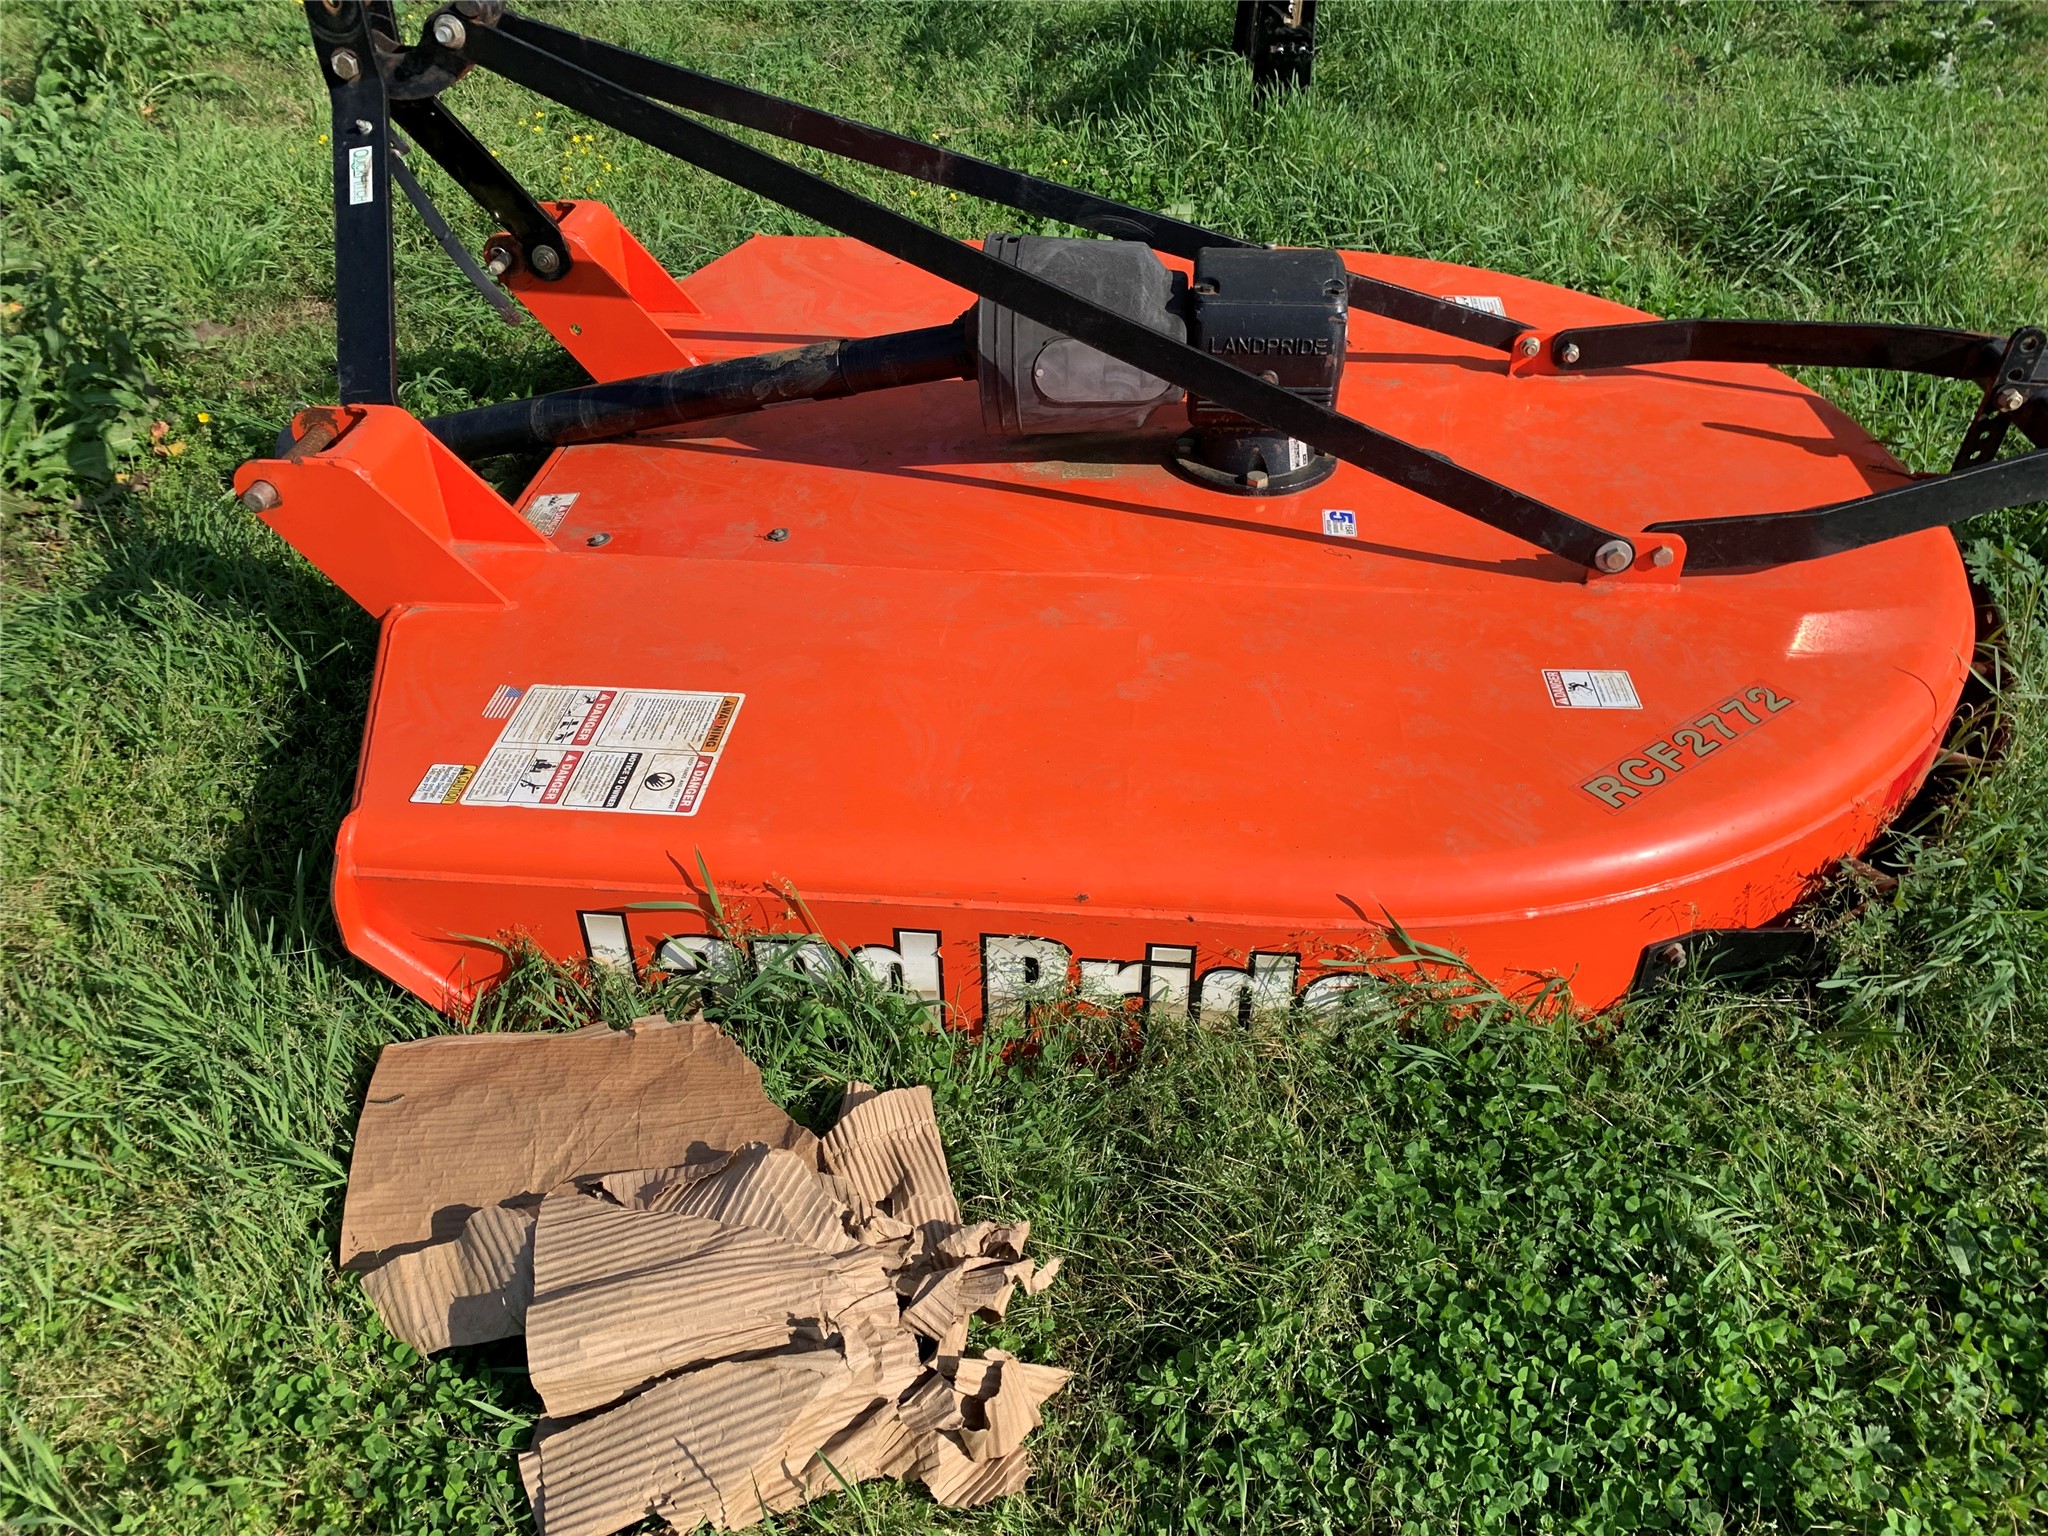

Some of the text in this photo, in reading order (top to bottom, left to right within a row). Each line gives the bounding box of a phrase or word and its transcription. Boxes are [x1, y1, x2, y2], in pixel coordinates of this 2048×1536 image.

[1208, 336, 1329, 356] LANDPRIDE
[1547, 672, 1564, 700] DANGER
[577, 703, 606, 741] DANGER
[705, 706, 731, 748] WANING
[1582, 686, 1793, 809] RCF2772
[622, 753, 639, 775] NOTICE
[444, 776, 469, 801] CAUTION
[545, 763, 573, 800] DANGER
[605, 784, 622, 807] OWNER
[680, 770, 706, 807] DANGER
